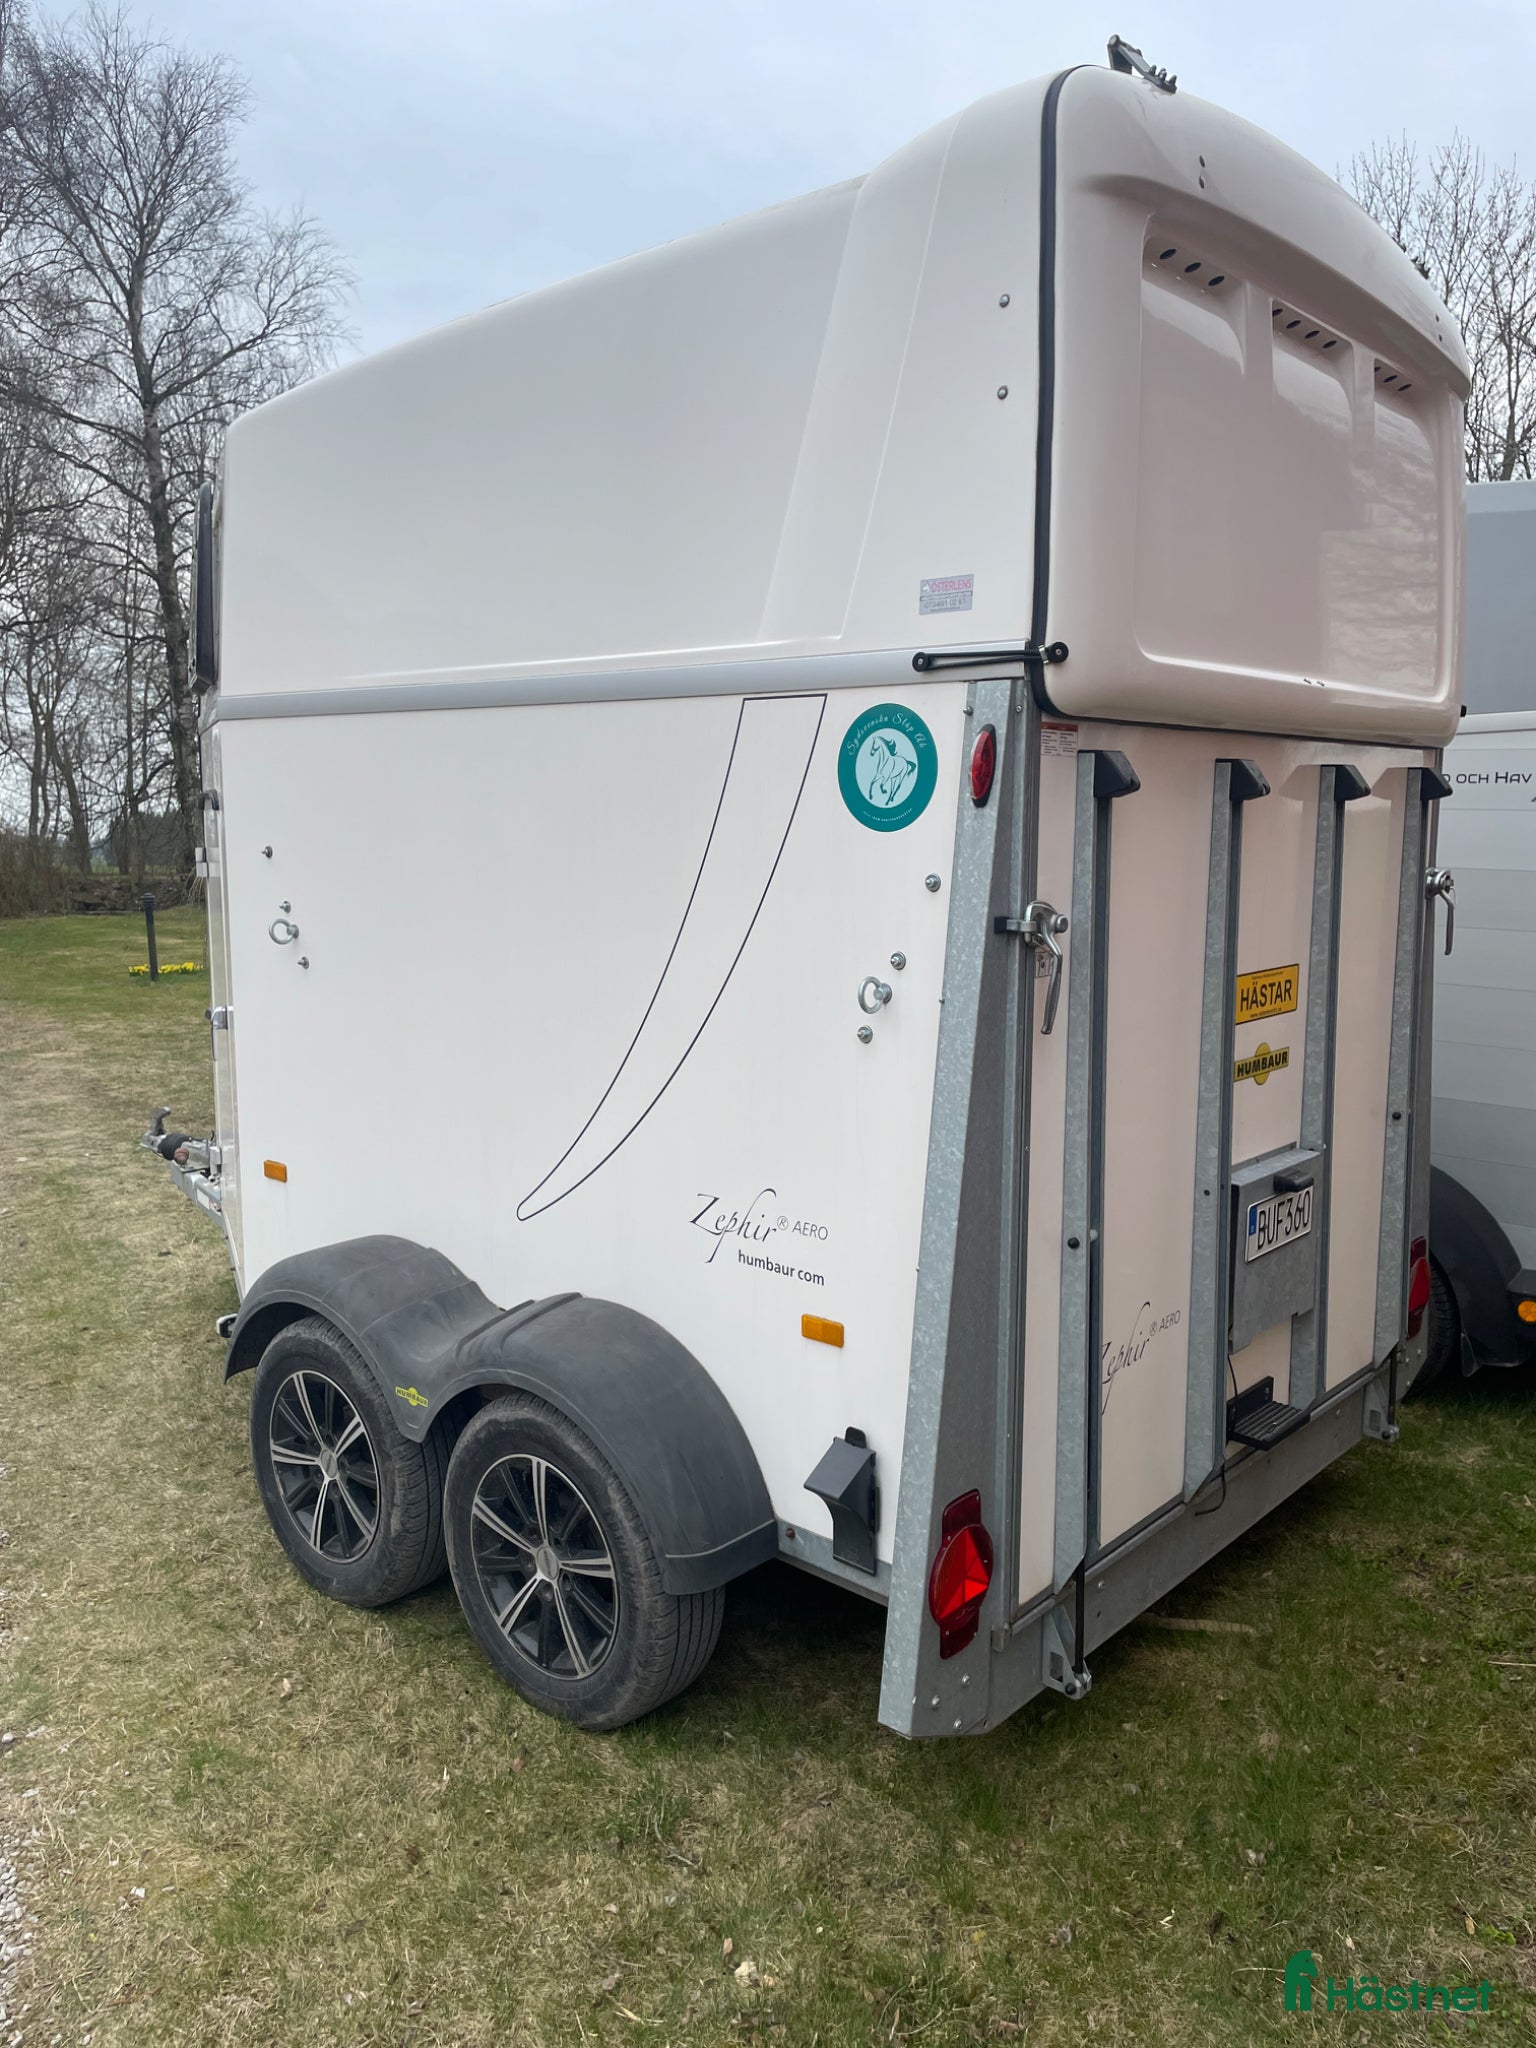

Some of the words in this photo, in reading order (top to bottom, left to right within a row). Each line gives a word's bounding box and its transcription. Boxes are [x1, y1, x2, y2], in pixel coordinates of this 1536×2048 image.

[932, 579, 971, 592] ÖSTERLENS
[1456, 773, 1489, 784] OCH
[1494, 771, 1532, 784] HAV
[1240, 979, 1292, 1012] HÄSTAR
[1237, 1051, 1288, 1077] HUMBAUR
[792, 1220, 829, 1241] AERO
[1159, 1310, 1181, 1332] AERO
